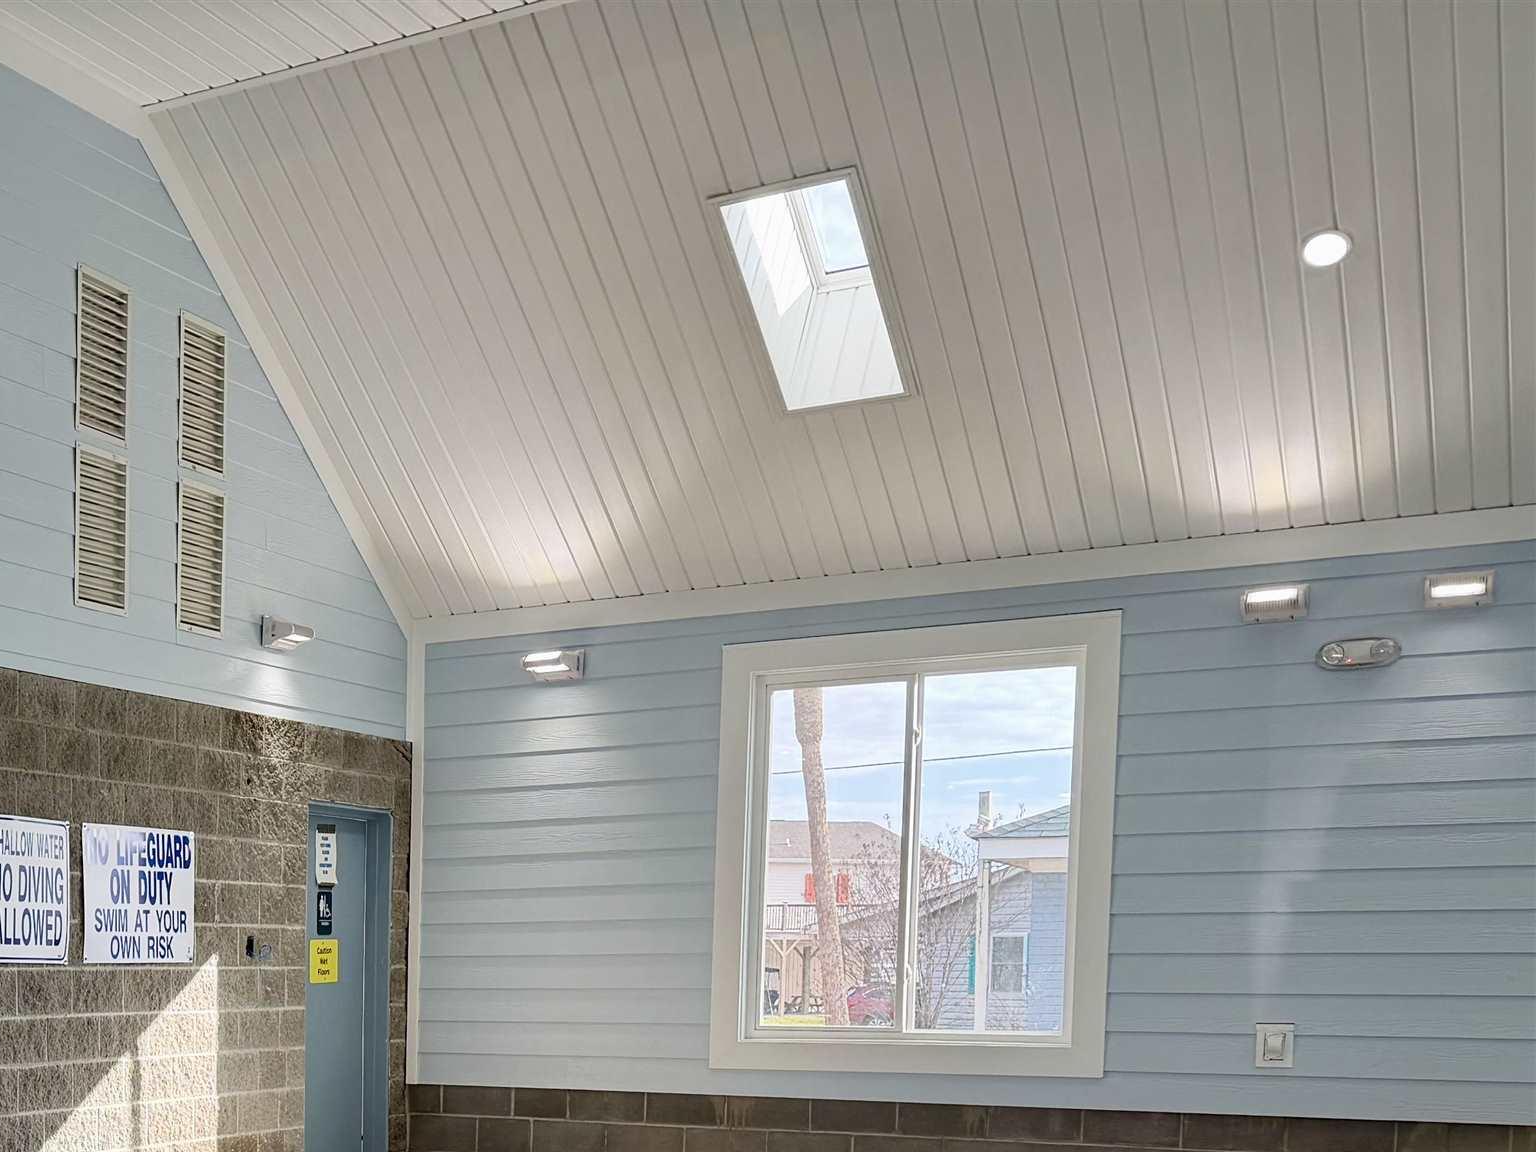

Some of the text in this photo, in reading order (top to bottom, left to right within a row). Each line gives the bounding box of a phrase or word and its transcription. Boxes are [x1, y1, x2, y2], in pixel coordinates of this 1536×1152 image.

[36, 833, 64, 860] WATER
[87, 829, 191, 869] NO LIFEGUARD
[18, 866, 64, 904] DIVING
[110, 869, 173, 906] ON DUTY
[94, 908, 187, 933] SWIM AT YOUR
[110, 936, 174, 959] OWN RISK
